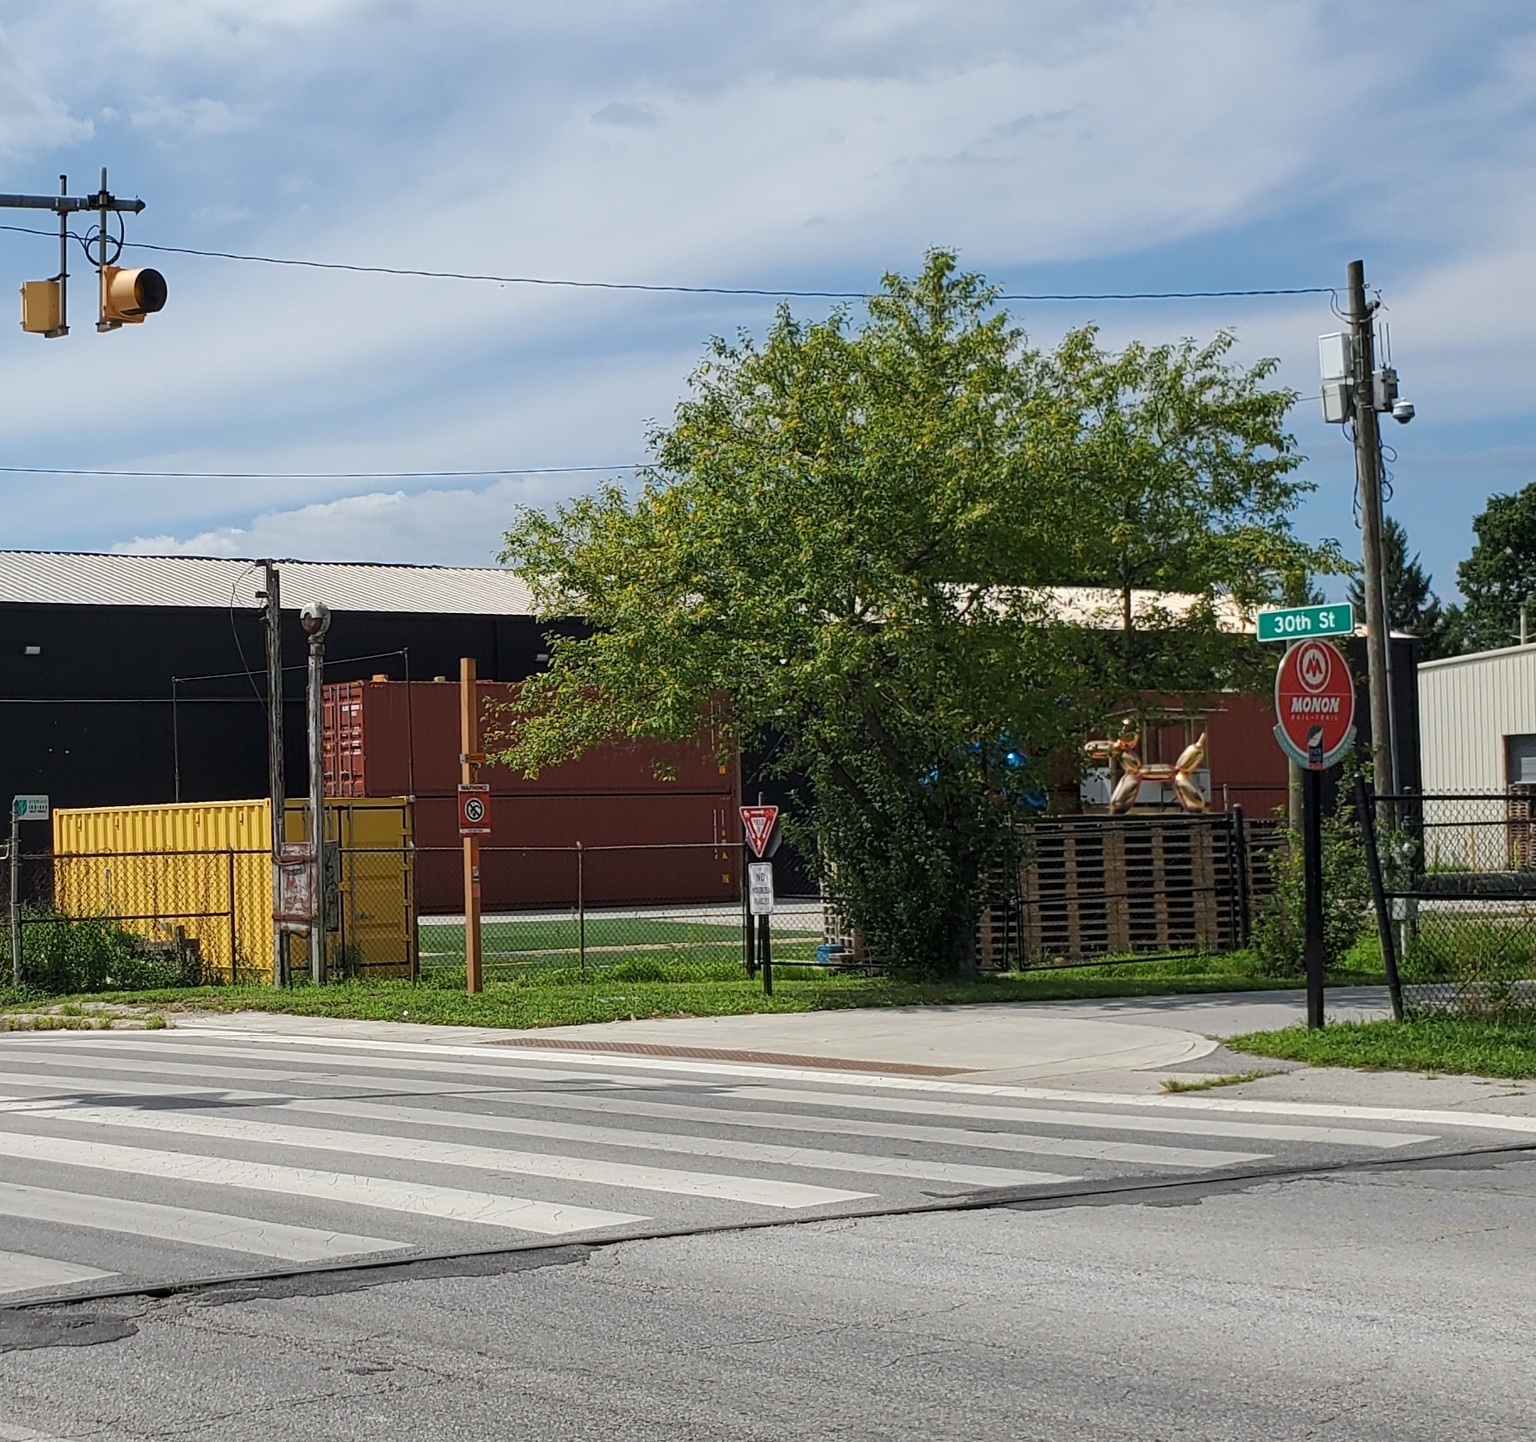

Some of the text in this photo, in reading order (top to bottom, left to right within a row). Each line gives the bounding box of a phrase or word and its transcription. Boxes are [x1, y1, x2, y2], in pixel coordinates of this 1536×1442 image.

[1274, 611, 1336, 633] 30th St
[1291, 697, 1341, 713] MONON
[755, 873, 765, 882] NO
